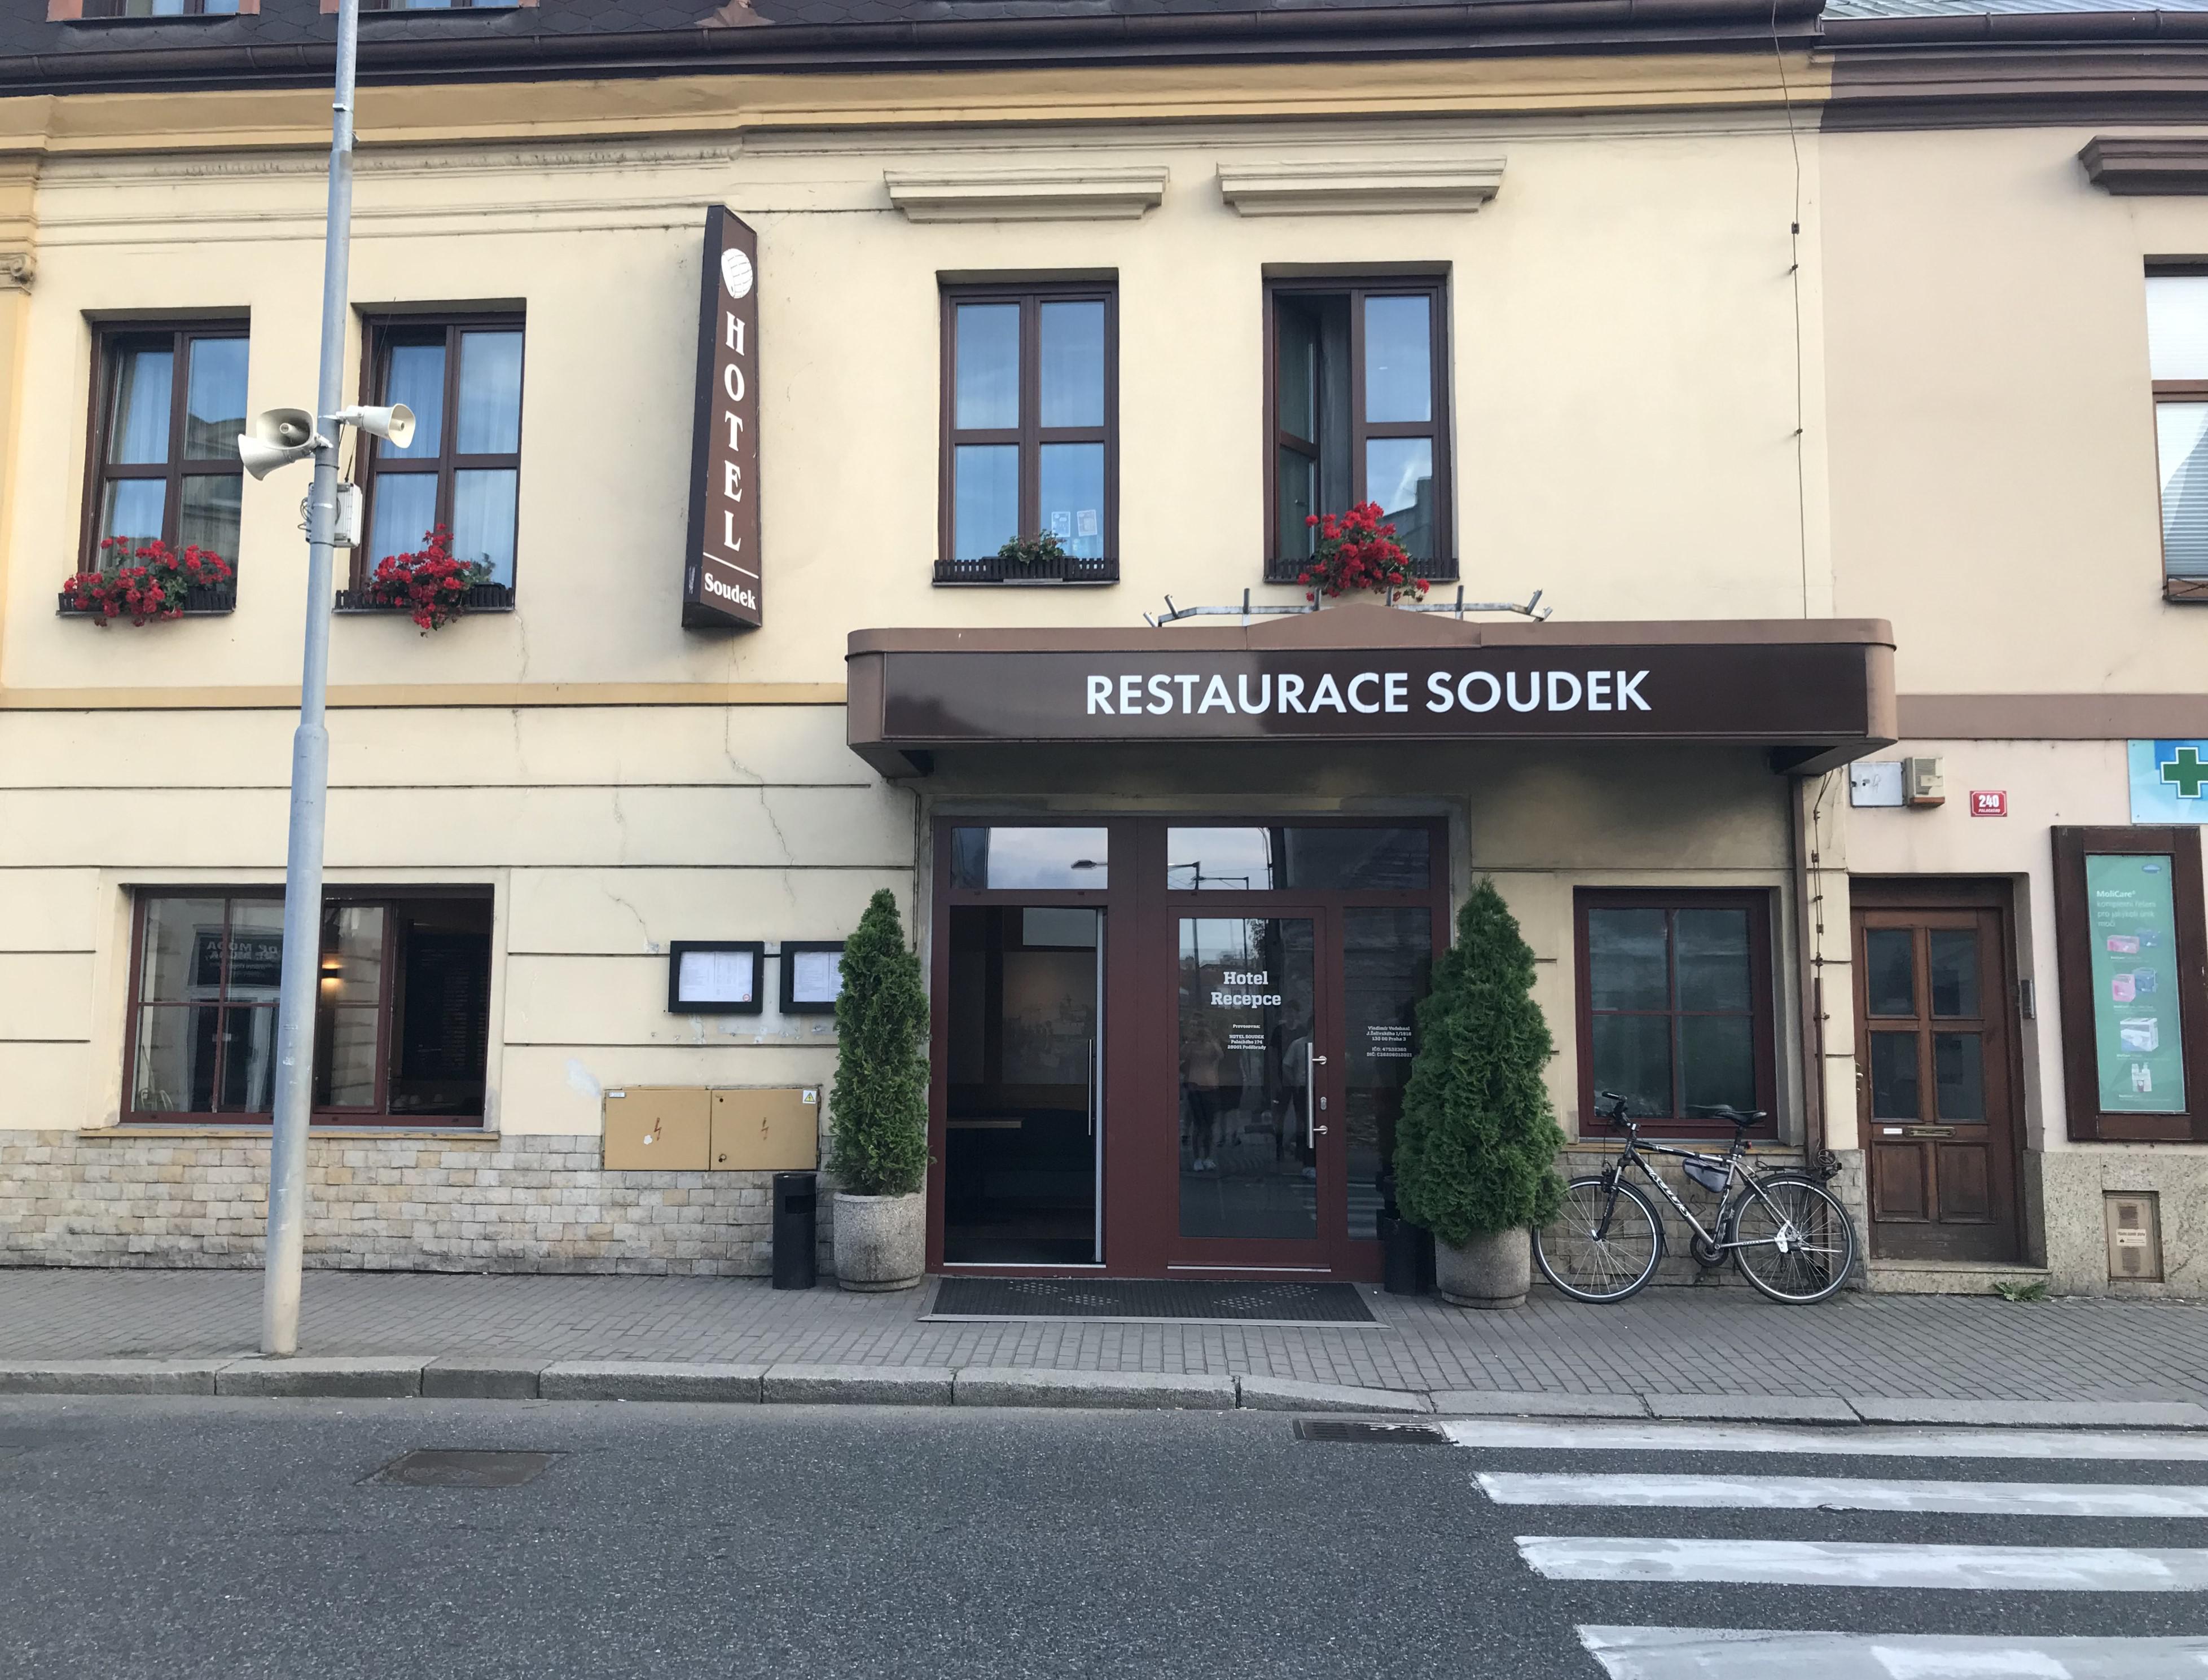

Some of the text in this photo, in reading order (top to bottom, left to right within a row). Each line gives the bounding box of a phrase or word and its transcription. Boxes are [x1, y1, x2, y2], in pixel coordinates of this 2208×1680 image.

[723, 311, 745, 552] HOTEL
[704, 574, 757, 610] Soudek
[1087, 671, 1652, 715] RESTAURACE SOUDEK
[1979, 794, 1999, 807] 240
[1223, 970, 1268, 985] Hotel
[1211, 992, 1281, 1009] Recepce
